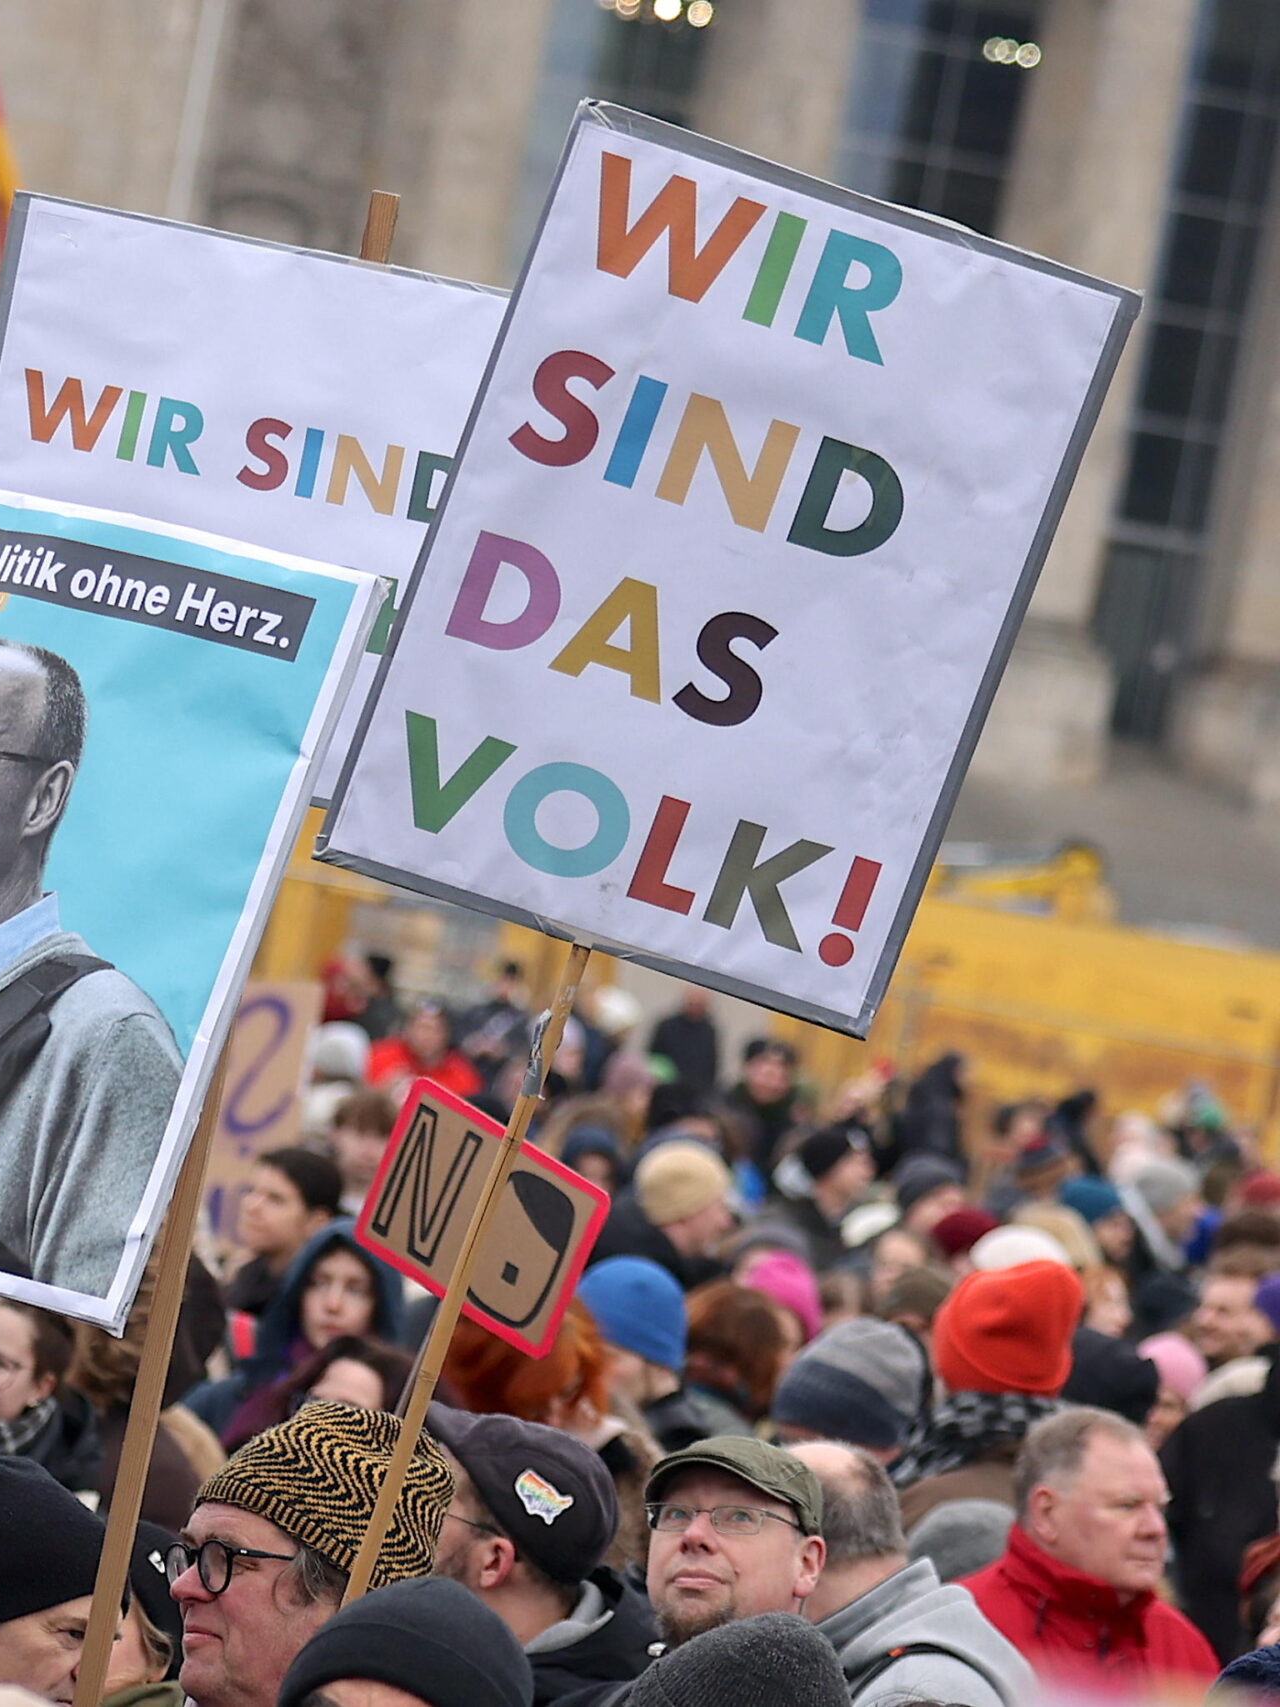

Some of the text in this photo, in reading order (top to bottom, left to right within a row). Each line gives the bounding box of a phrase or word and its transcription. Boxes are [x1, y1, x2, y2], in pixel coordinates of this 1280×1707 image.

[595, 150, 905, 367] WIR
[24, 367, 205, 477] WIR
[507, 348, 906, 558] SIND
[69, 564, 174, 617] ohne
[174, 582, 292, 650] Herz.
[445, 530, 780, 728] DAS
[404, 709, 884, 968] VOLK!
